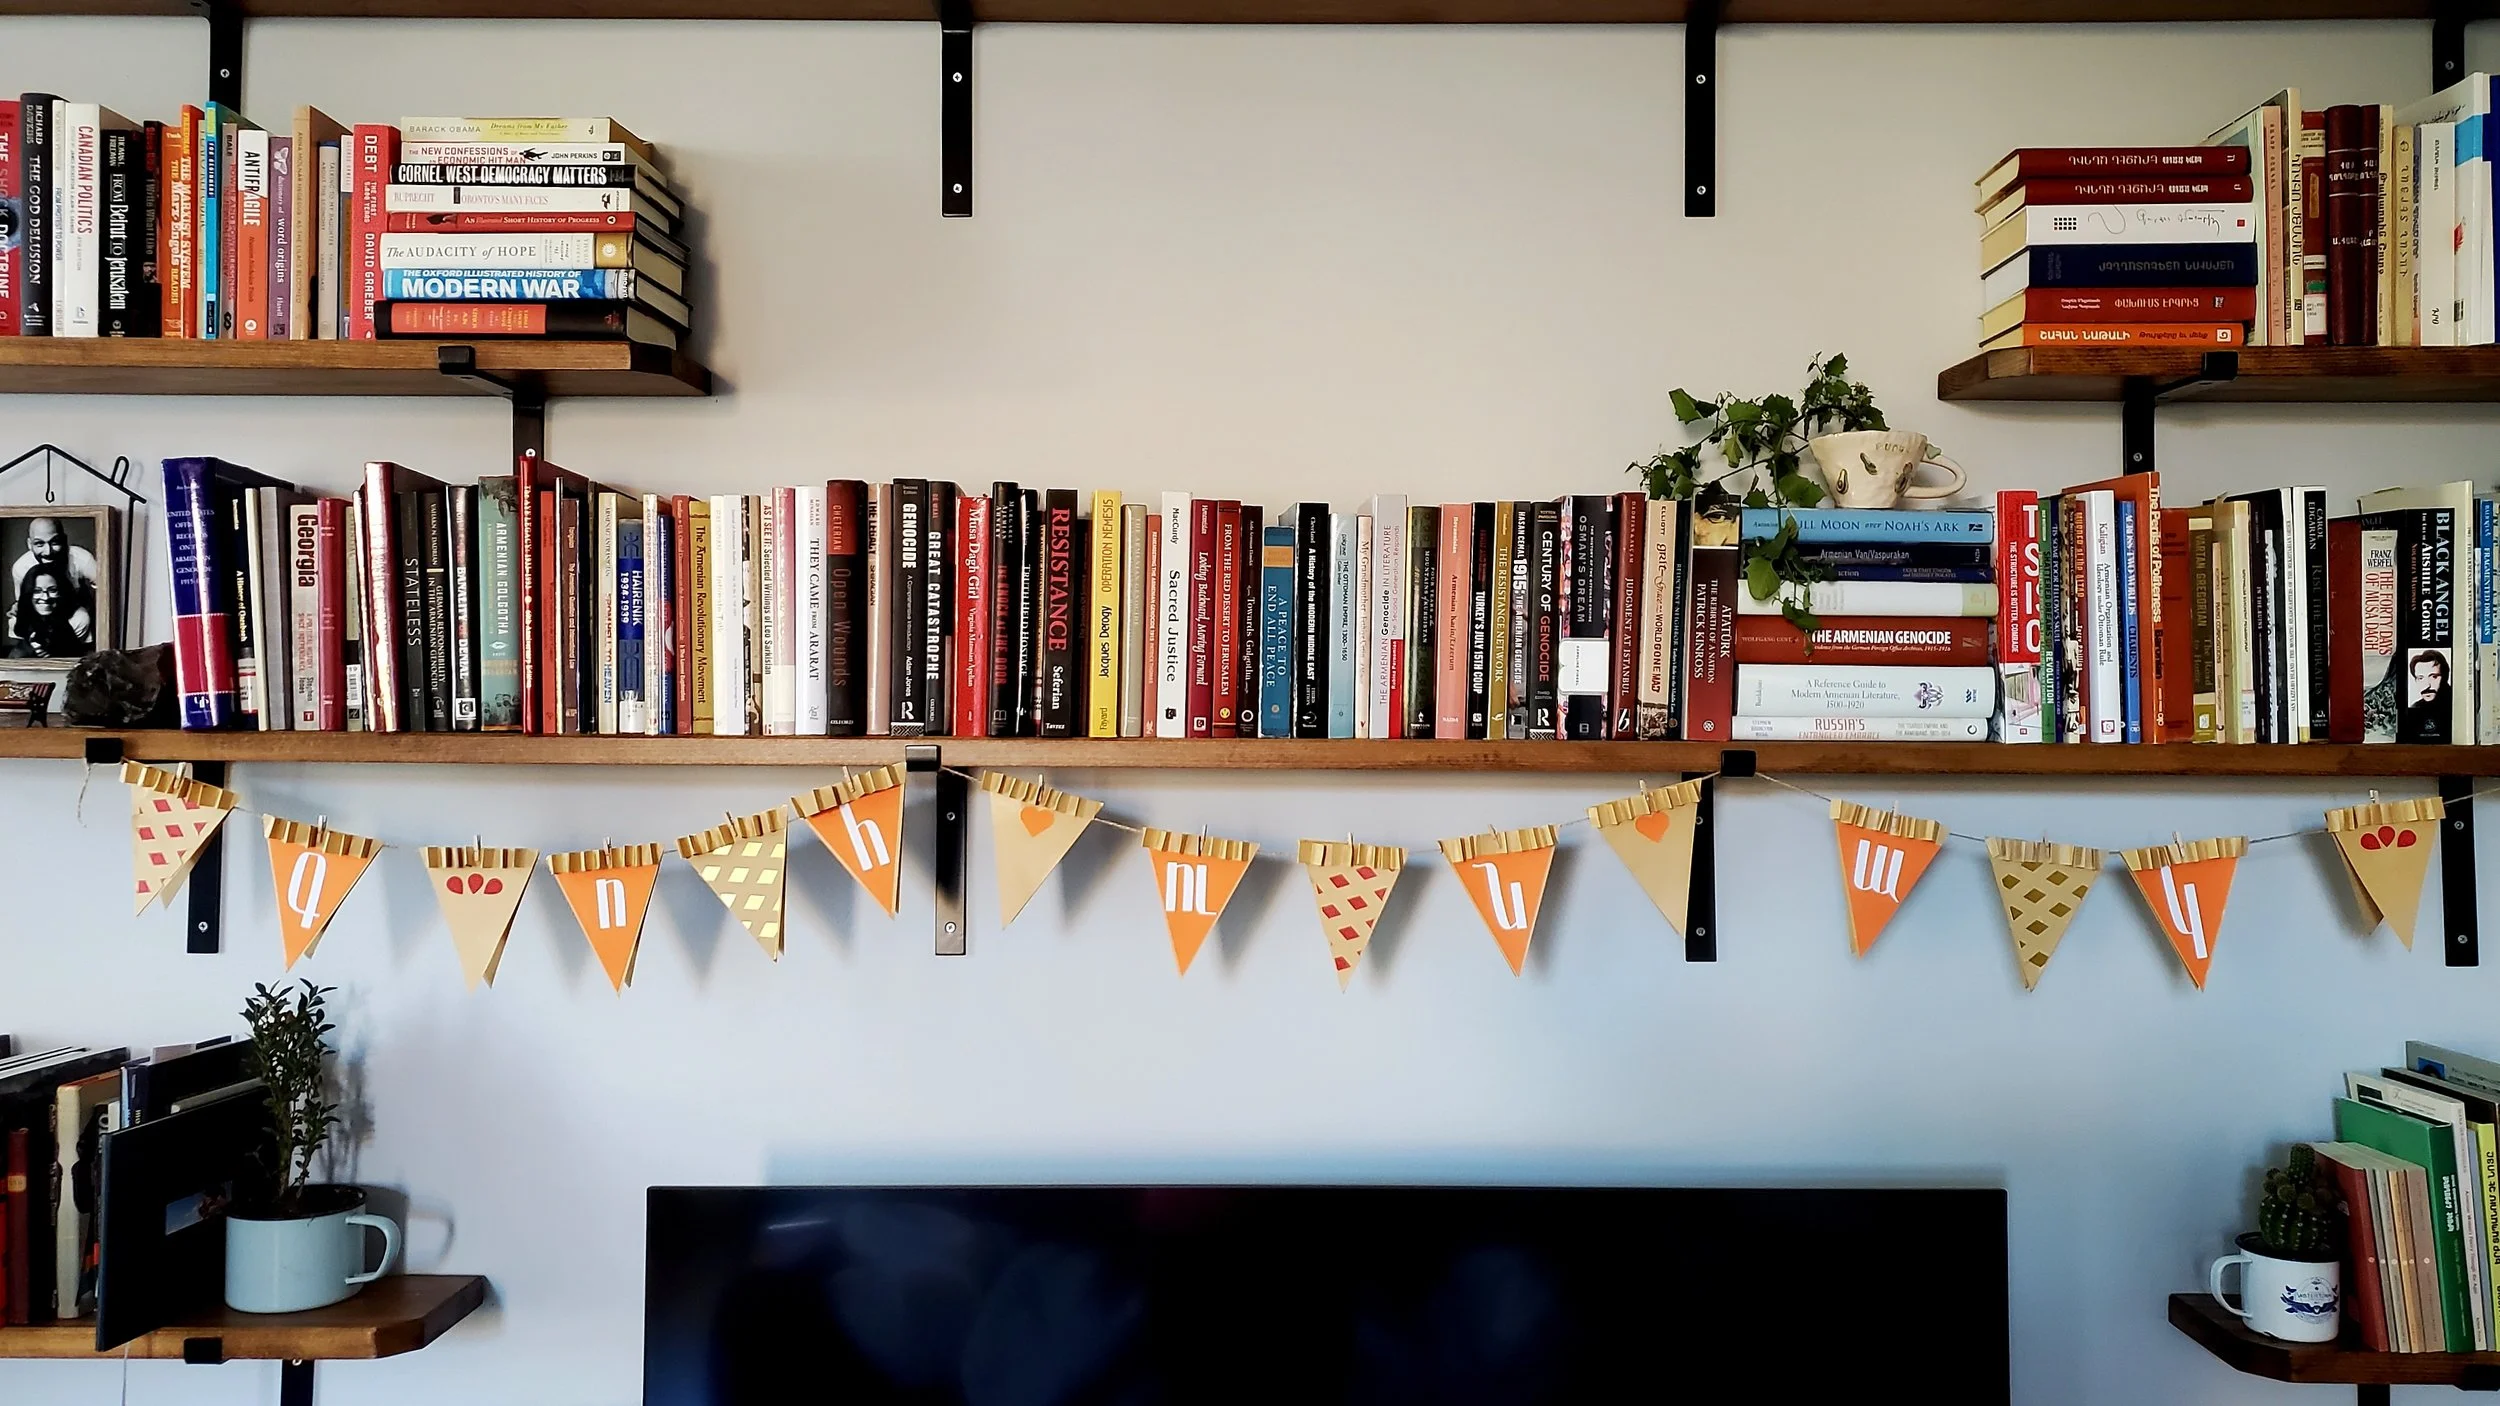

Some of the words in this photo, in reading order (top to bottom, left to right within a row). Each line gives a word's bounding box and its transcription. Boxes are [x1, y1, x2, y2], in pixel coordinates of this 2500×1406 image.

[35, 105, 43, 144] RICHARD
[29, 155, 41, 181] THE
[78, 126, 93, 180] CANADIAN
[364, 135, 377, 172] DEBT
[421, 148, 442, 156] NEW
[444, 147, 509, 156] CONFESSIONS
[113, 174, 124, 202] FROM
[243, 151, 260, 226] ANTIFRAGILE
[399, 165, 440, 183] CORNEL
[444, 165, 479, 183] WEST
[481, 166, 550, 184] DEMOCRACY
[553, 166, 607, 185] MATTERS
[29, 185, 40, 217] GOD
[78, 185, 92, 234] POLITICS
[2400, 165, 2409, 223] ՏԵՐՅԱՆ
[110, 204, 129, 239] Beirut
[2292, 206, 2302, 266] ՊԱՐՈՅՐ
[29, 219, 40, 285] DELUSION
[113, 241, 124, 255] TO
[364, 233, 374, 267] DAVID
[386, 247, 404, 257] The
[406, 246, 477, 257] AUDACITY
[482, 246, 492, 258] of
[498, 246, 537, 256] HOPE
[2400, 231, 2409, 278] ՎԱՀԱՆ
[104, 257, 129, 309] Jerusalem
[364, 272, 374, 319] GRAEBER
[402, 279, 517, 298] MODERN
[522, 279, 580, 298] WAR
[2115, 298, 2159, 308] ՓԱԽՈՒՍՏ
[2163, 298, 2199, 308] ԷՐԳՐԻՑ
[2039, 330, 2079, 340] ՇԱՀԱՆ
[2082, 330, 2131, 340] ՆԱԹԱԼԻ
[2150, 486, 2160, 508] The
[696, 526, 706, 544] The
[833, 505, 842, 551] CHETERIAN
[902, 503, 917, 568] GENOCIDE
[968, 508, 980, 540] Musa
[1102, 499, 1113, 539] NEMESIS
[1170, 507, 1180, 545] MacCurdy
[1223, 524, 1233, 550] FROM
[1518, 512, 1526, 535] HASAN
[1821, 520, 1860, 530] MOON
[1884, 521, 1931, 532] NOAH'S
[1934, 521, 1959, 532] ARK
[2150, 508, 2160, 545] Perils
[2308, 501, 2317, 550] EDGARIAN
[295, 514, 319, 587] Georgia
[496, 522, 508, 576] ARMENIAN
[809, 538, 820, 571] THEY
[928, 531, 941, 575] GREAT
[966, 542, 980, 573] Dagh
[1359, 541, 1369, 555] My
[1499, 547, 1508, 567] THE
[1517, 536, 1526, 558] CEMAL
[1578, 515, 1588, 573] OSMAN'S
[2098, 523, 2109, 555] Kaligian
[2151, 546, 2161, 559] of
[2195, 534, 2206, 569] VARTAN
[2435, 512, 2450, 574] BLACK
[696, 547, 707, 589] Armenian
[1101, 542, 1112, 593] OPERATION
[1223, 552, 1232, 572] THE
[1512, 558, 1527, 594] 1915:
[1541, 531, 1552, 589] CENTURY
[2421, 542, 2433, 595] ARSHILE
[809, 574, 820, 608] CAME
[830, 568, 851, 610] Open
[968, 575, 980, 599] Girl
[1048, 507, 1070, 651] RESISTANCE
[1167, 570, 1181, 621] Sacred
[1222, 573, 1232, 592] RED
[1360, 556, 1369, 612] Grandmother
[2152, 559, 2163, 623] Politeness
[2365, 573, 2379, 587] OF
[2379, 570, 2393, 589] THE
[404, 558, 421, 646] STATELESS
[496, 581, 509, 635] GOLGOTHA
[620, 572, 629, 624] 1934-1939
[631, 570, 643, 626] HAIRENIK
[1222, 594, 1231, 627] DESERT
[1266, 585, 1277, 612] END
[1278, 597, 1287, 606] A
[1474, 591, 1485, 630] TURKEY'S
[1496, 570, 1507, 629] RESISTANCE
[1515, 595, 1524, 609] THE
[1541, 594, 1551, 612] OF
[1577, 578, 1587, 623] DREAM
[1624, 578, 1634, 632] JUDGMENT
[1695, 583, 1706, 629] PATRICK
[2196, 573, 2208, 627] GREGORIAN
[2365, 590, 2379, 620] MUSA
[2379, 593, 2393, 627] FORTY
[2435, 577, 2449, 642] ANGEL
[694, 592, 707, 653] Revolutionary
[927, 583, 940, 680] CATASTROPHE
[1099, 605, 1111, 638] Derogy
[1245, 597, 1256, 637] Towards
[1266, 617, 1277, 642] ALL
[1277, 611, 1287, 654] PEACE
[1514, 611, 1524, 648] ARMENIAN
[1720, 605, 1732, 658] ATATÜRK
[2421, 599, 2433, 642] GORKY
[832, 620, 851, 687] Wounds
[1167, 627, 1180, 682] Justice
[1222, 630, 1230, 642] TO
[1474, 631, 1484, 649] JULY
[1539, 616, 1550, 682] GENOCIDE
[1623, 634, 1632, 646] AT
[1812, 630, 1831, 643] THE
[1833, 630, 1893, 643] ARMENIAN
[1896, 630, 1951, 645] GENOCIDE
[2154, 629, 2164, 680] Baronian
[2364, 622, 2378, 650] DAGH
[2379, 631, 2393, 656] DAYS
[809, 631, 820, 681] ARARAT
[905, 656, 913, 675] Adam
[1098, 642, 1111, 678] Jacques
[1221, 644, 1230, 695] JERUSALEM
[1243, 640, 1255, 680] Golgotha
[1266, 647, 1276, 687] PEACE
[1277, 657, 1287, 676] TO
[1473, 650, 1484, 670] 15TH
[1495, 632, 1505, 682] NETWORK
[1514, 649, 1522, 684] GENOCIDE
[1621, 649, 1632, 696] ISTANBUL
[1694, 632, 1705, 679] KINROSS
[697, 656, 707, 703] Movement
[905, 676, 913, 696] Jones
[1051, 665, 1064, 710] Seferian
[1473, 672, 1483, 694] COUP
[1815, 718, 1865, 731] RUSSIA'S
